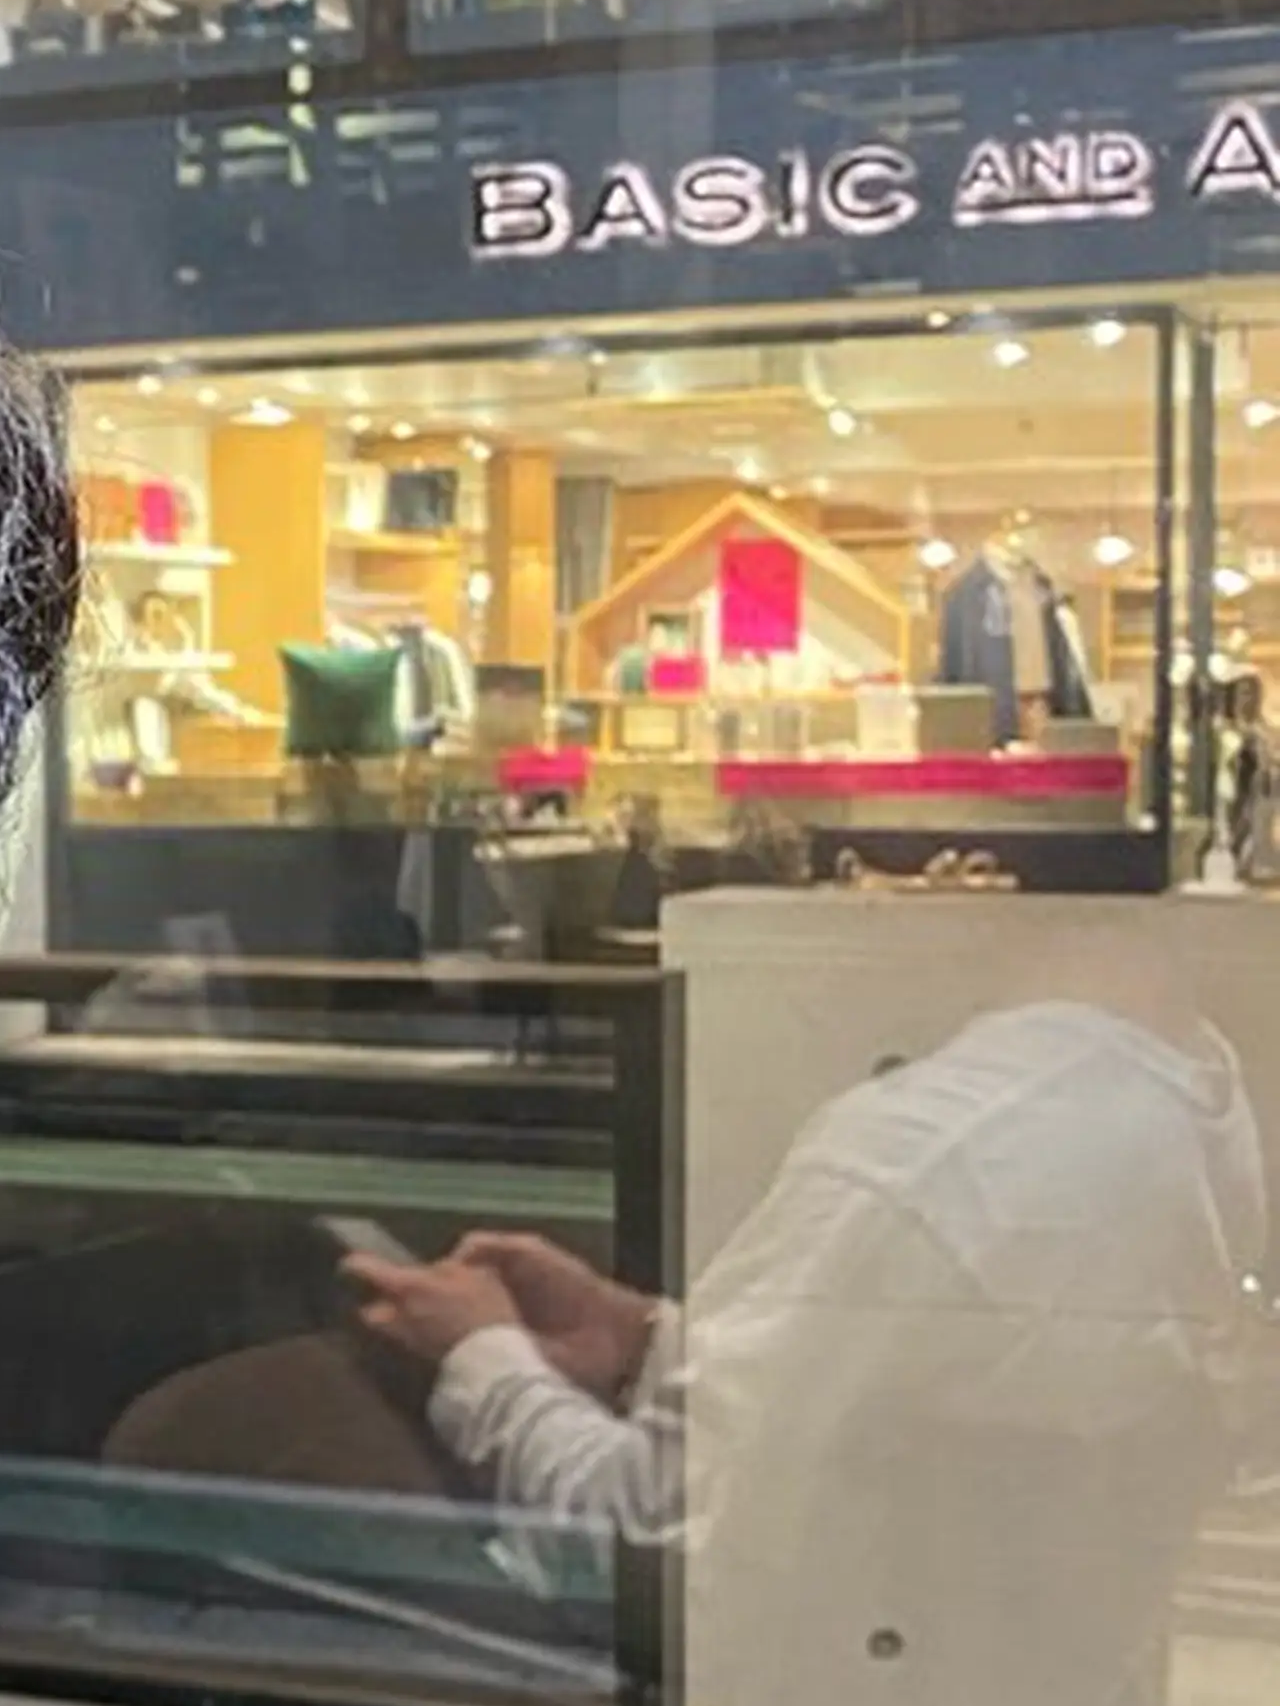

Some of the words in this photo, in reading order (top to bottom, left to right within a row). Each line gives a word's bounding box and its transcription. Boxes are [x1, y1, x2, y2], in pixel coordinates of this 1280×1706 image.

[470, 145, 919, 260] BASIC
[955, 131, 1153, 209] AND
[1186, 99, 1280, 203] A
